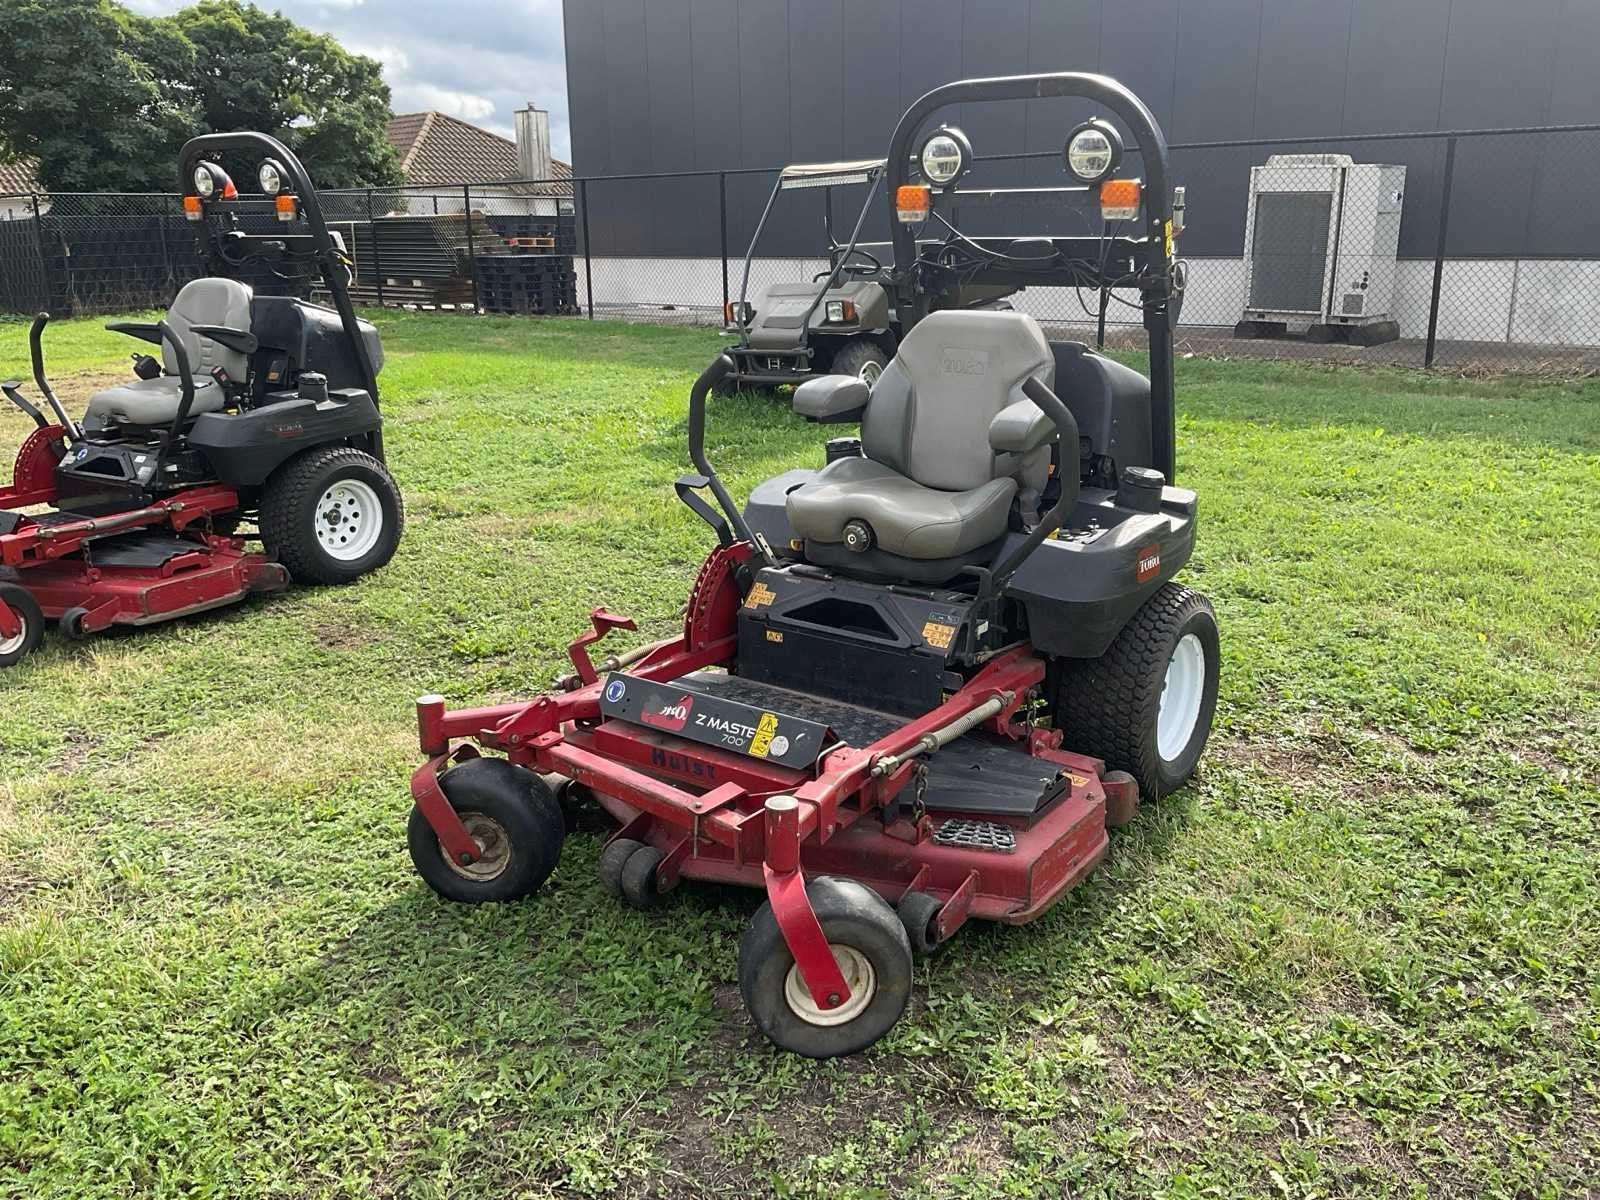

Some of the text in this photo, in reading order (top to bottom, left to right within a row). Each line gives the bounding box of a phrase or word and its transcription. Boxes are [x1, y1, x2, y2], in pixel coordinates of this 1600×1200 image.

[695, 713, 757, 738] Z MASTE
[721, 733, 744, 747] 700
